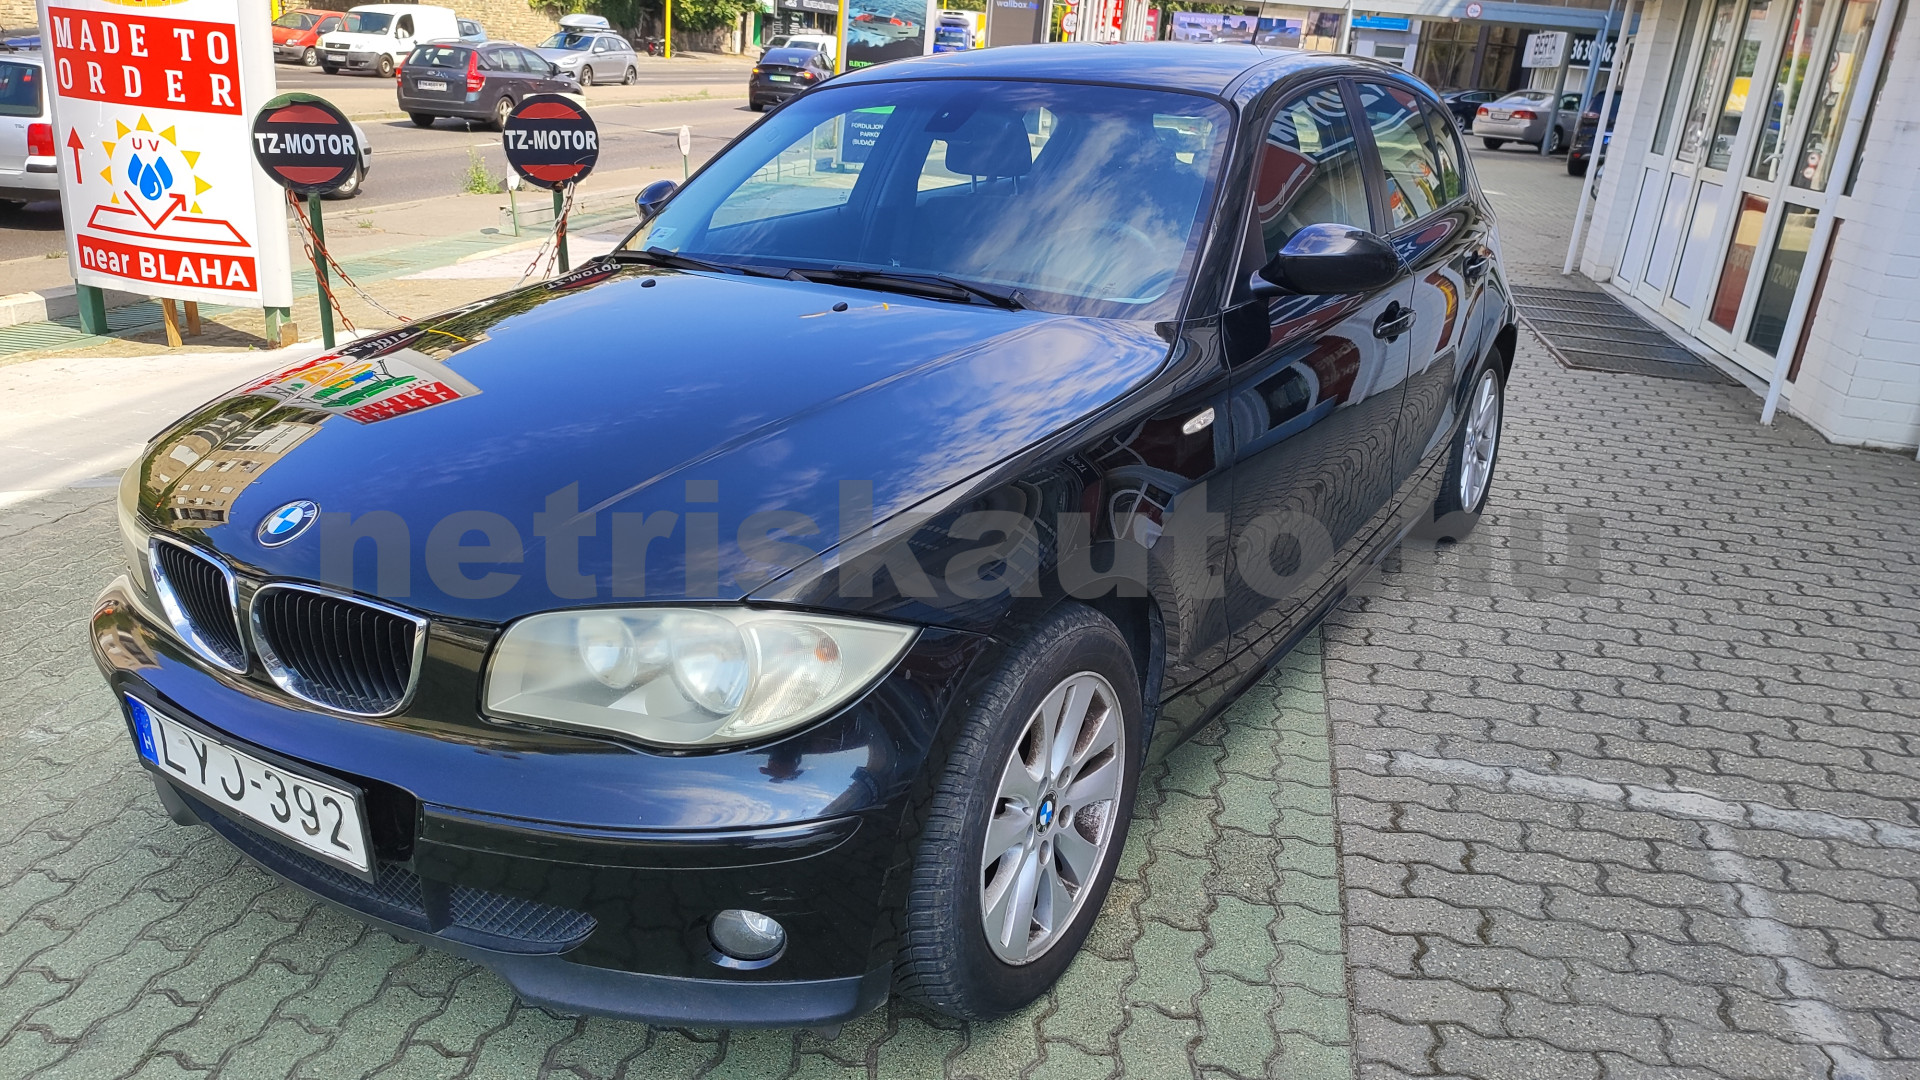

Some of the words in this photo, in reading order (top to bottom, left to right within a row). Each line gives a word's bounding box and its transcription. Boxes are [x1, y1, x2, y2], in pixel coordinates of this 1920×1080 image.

[53, 15, 148, 58] MADE
[173, 27, 230, 65] TO
[1533, 33, 1556, 56] BERTA
[1570, 38, 1584, 60] 36
[58, 58, 235, 108] ORDER
[132, 137, 160, 152] UV
[254, 132, 356, 156] TZ-MOTOR
[504, 129, 598, 151] TZ-MOTOR
[82, 244, 130, 274] near
[139, 251, 250, 288] BLAHA
[143, 735, 155, 755] H
[153, 714, 352, 852] LYJ-392
